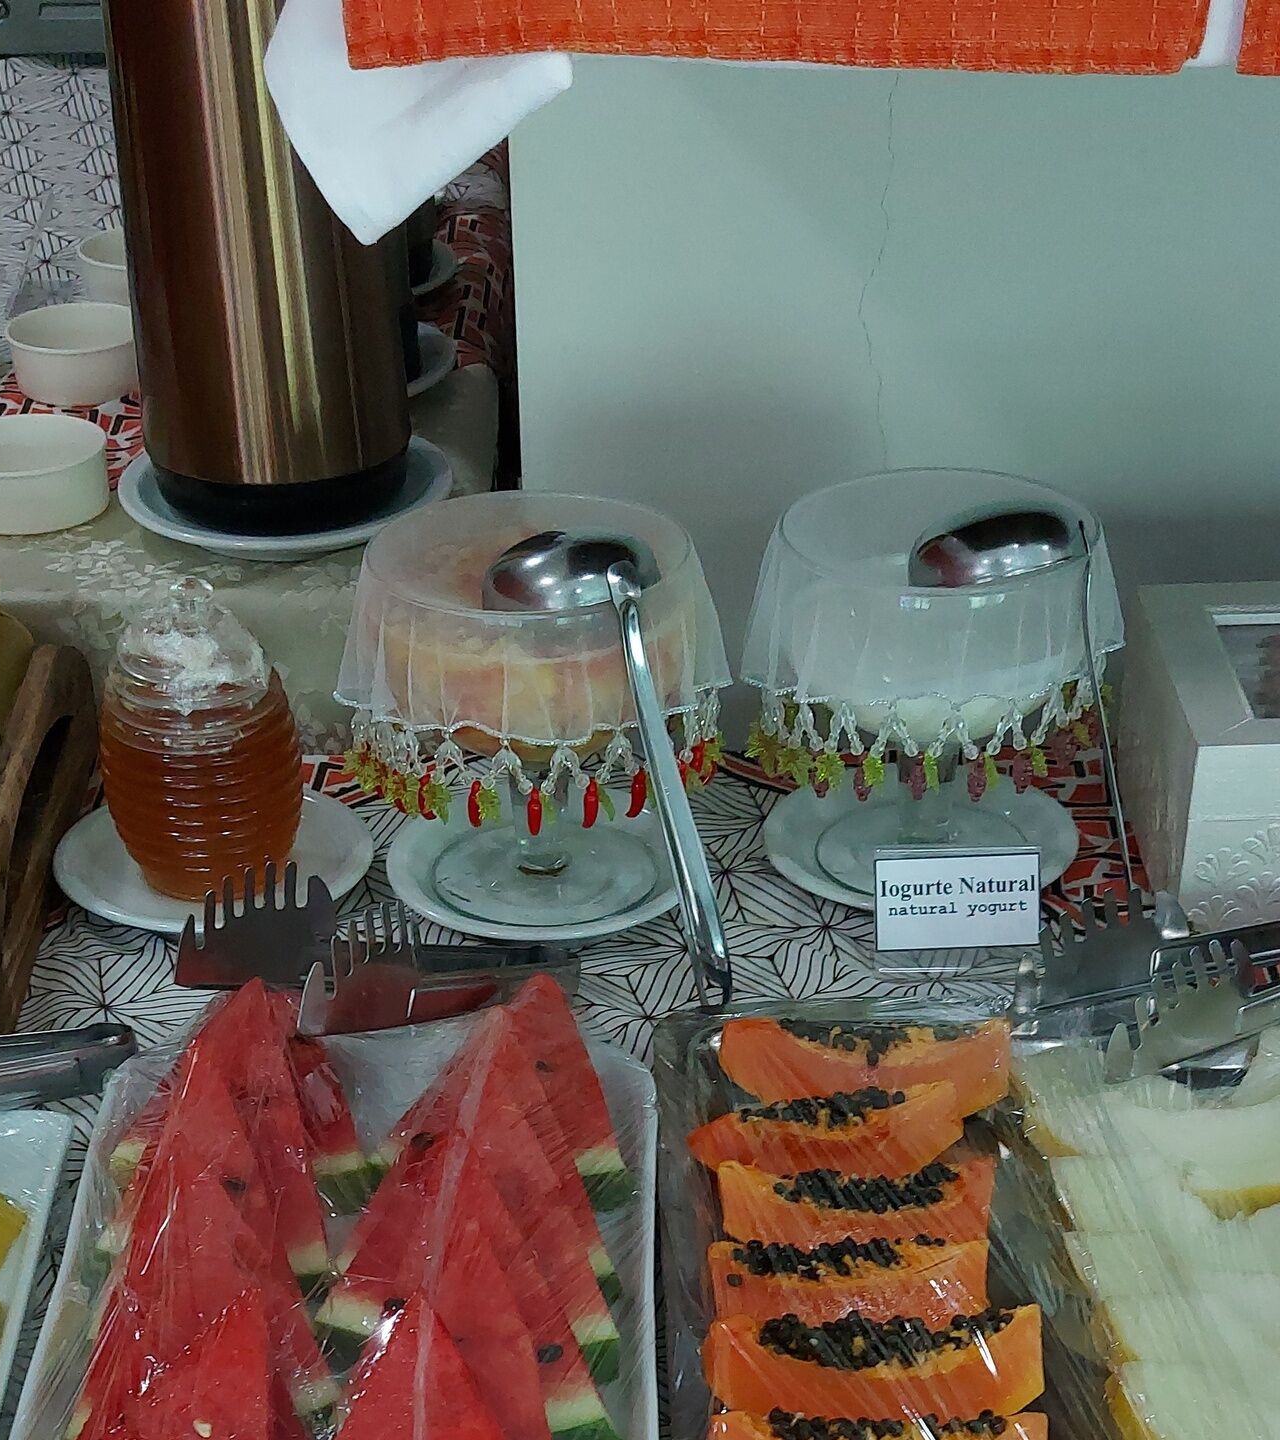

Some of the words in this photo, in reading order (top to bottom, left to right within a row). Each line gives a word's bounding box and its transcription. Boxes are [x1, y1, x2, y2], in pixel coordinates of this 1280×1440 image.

[880, 880, 953, 901] Iogurte
[959, 875, 1035, 894] Natural
[888, 902, 958, 916] natural
[966, 900, 1028, 917] yogurt
